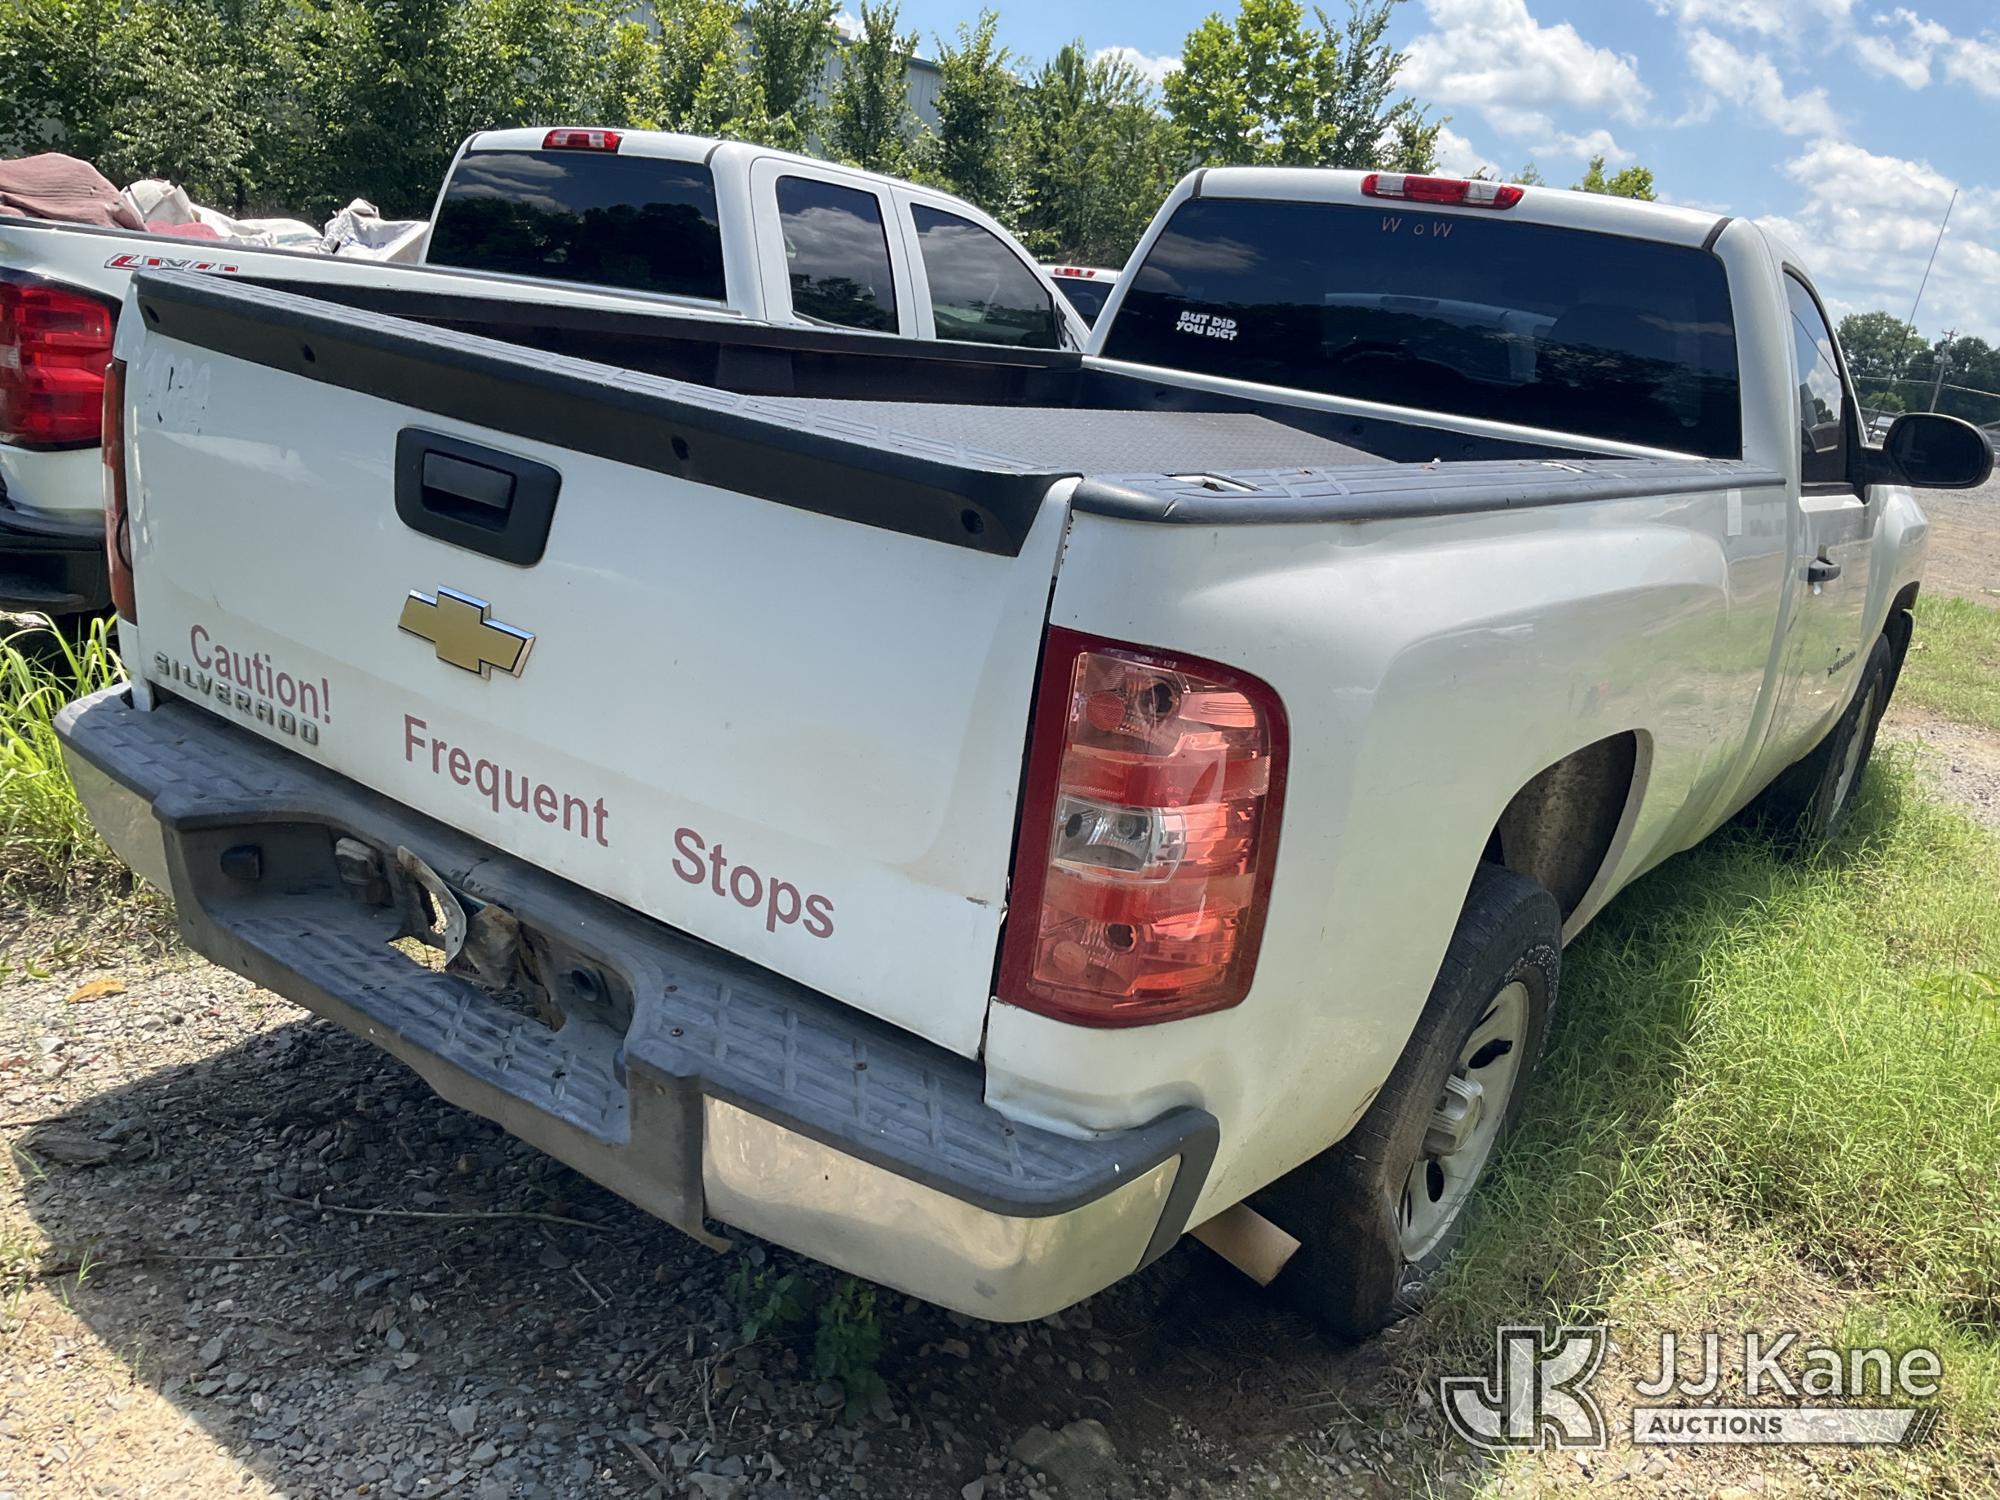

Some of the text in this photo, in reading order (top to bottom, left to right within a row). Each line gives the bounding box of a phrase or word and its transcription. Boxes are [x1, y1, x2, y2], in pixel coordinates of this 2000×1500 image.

[1176, 321, 1204, 334] YOU
[1180, 311, 1209, 324] BUT
[154, 651, 319, 746] SILVERADO
[190, 624, 331, 724] Caution!
[404, 713, 834, 938] Frequent Stops
